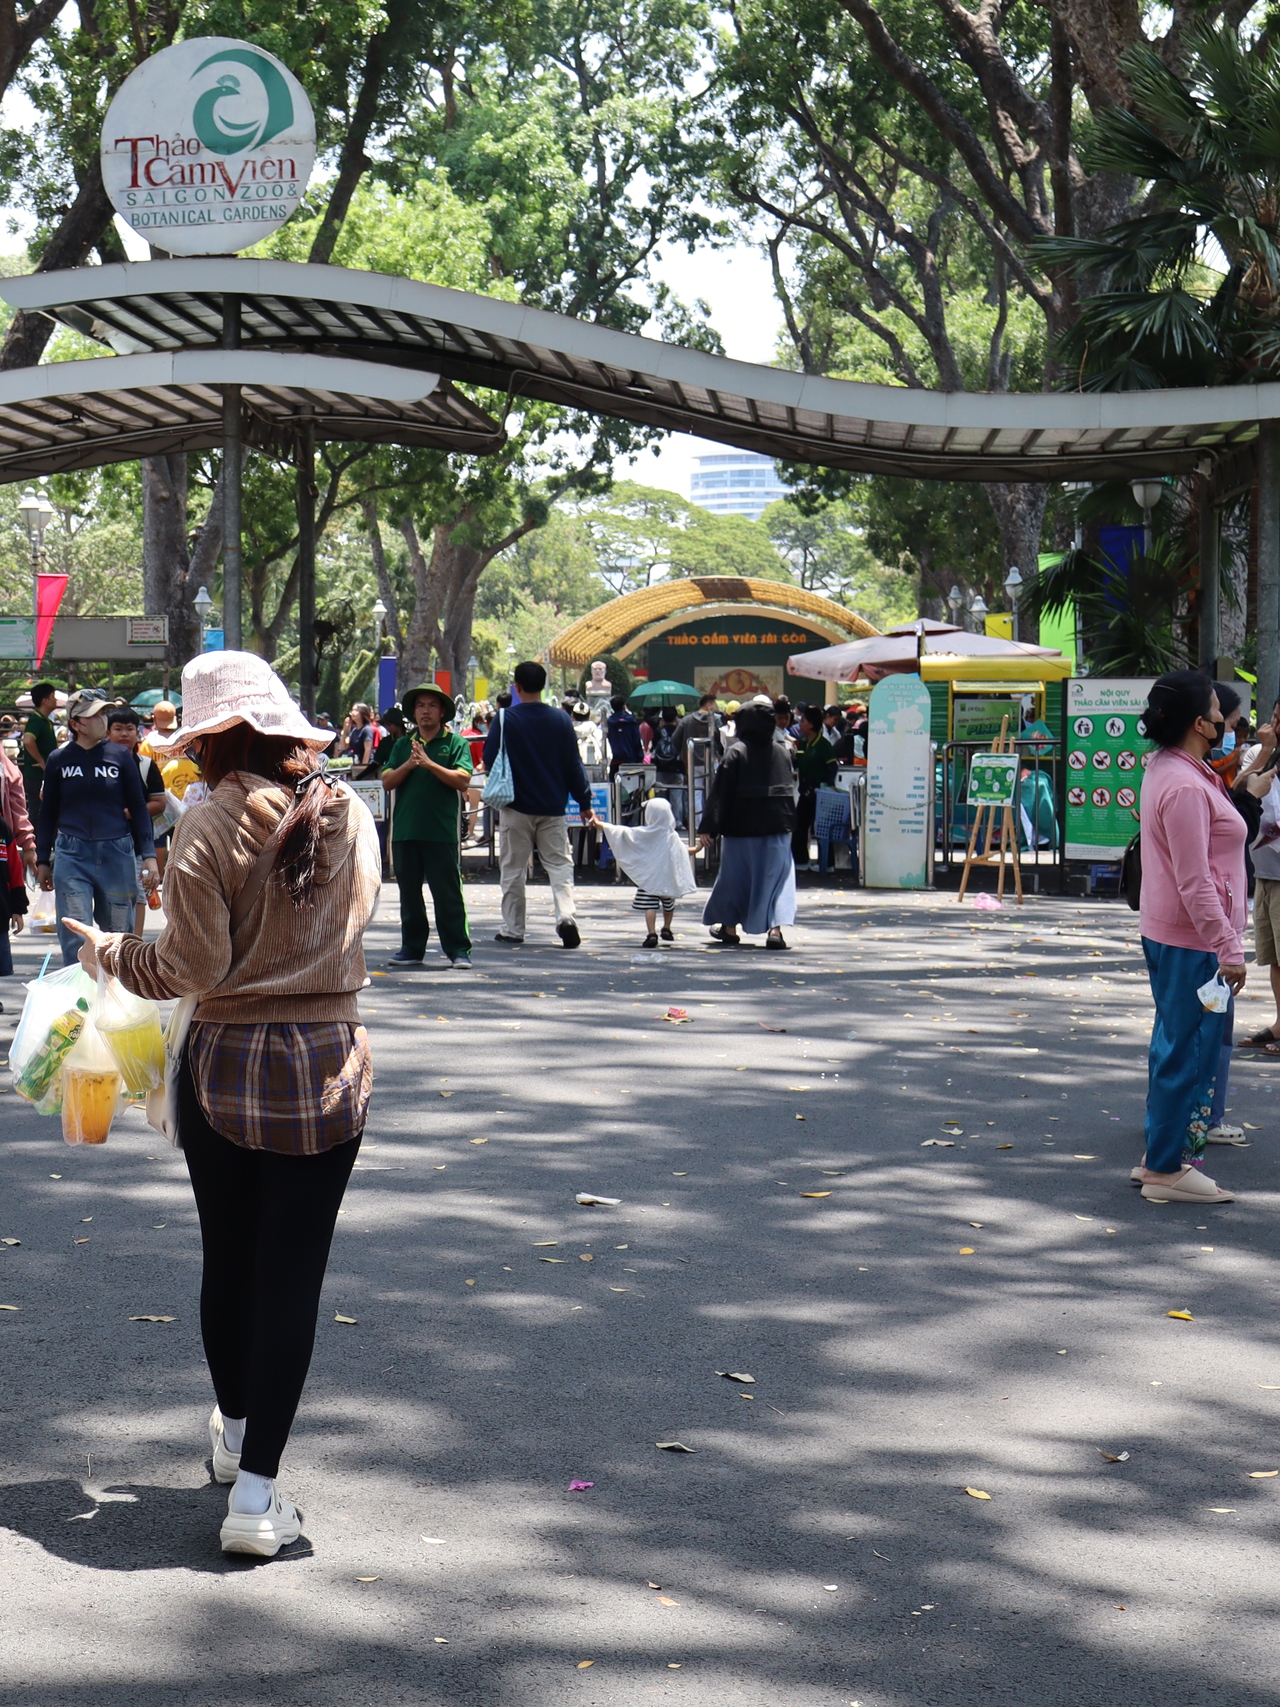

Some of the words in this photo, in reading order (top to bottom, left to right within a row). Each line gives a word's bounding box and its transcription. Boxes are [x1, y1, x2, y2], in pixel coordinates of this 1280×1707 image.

[115, 133, 201, 188] Thảo
[214, 156, 296, 199] Viên
[126, 187, 225, 206] SAIGON
[131, 209, 216, 227] BOTANICAL
[222, 204, 288, 221] GARDENS
[1100, 689, 1114, 698] NỘI
[1115, 690, 1131, 698] QUY
[61, 765, 84, 779] WA
[94, 765, 120, 778] NG
